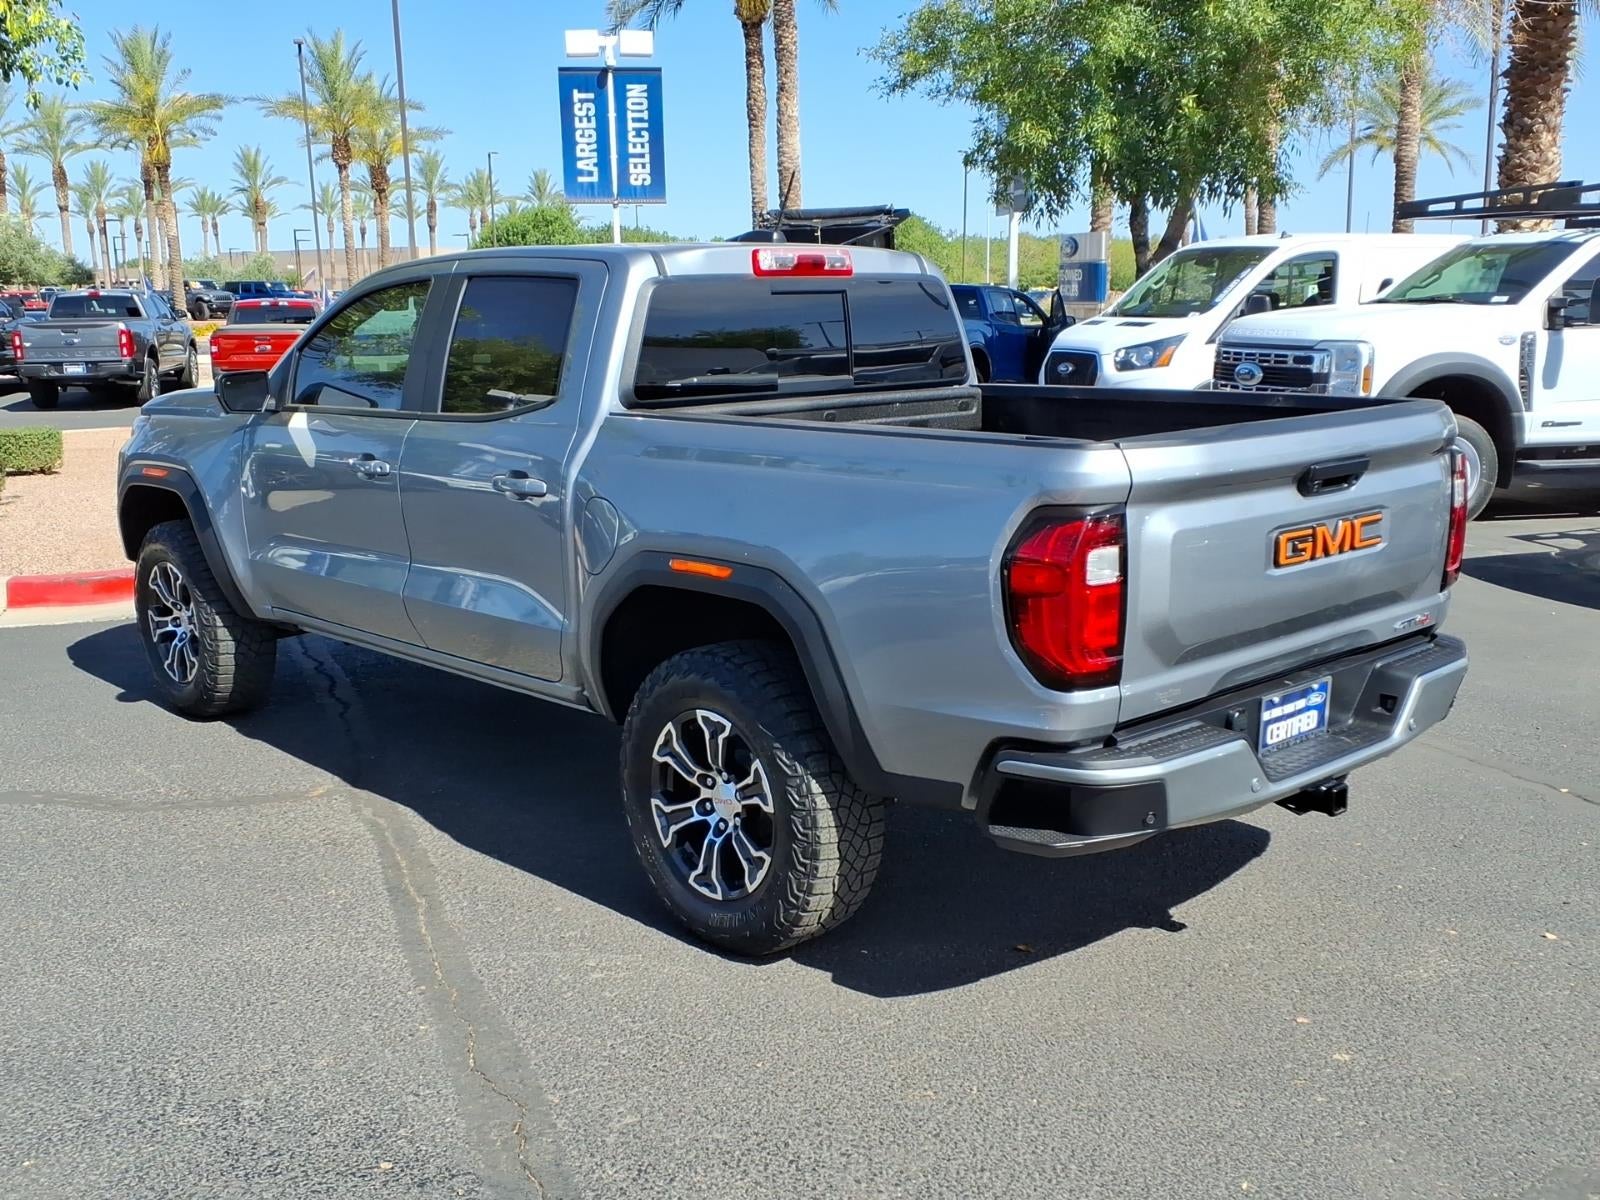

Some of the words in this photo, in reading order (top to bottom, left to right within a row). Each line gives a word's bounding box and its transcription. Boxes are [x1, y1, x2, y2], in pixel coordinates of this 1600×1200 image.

[573, 88, 599, 183] LARGEST
[626, 83, 652, 187] SELECTION
[1274, 511, 1382, 568] GMC
